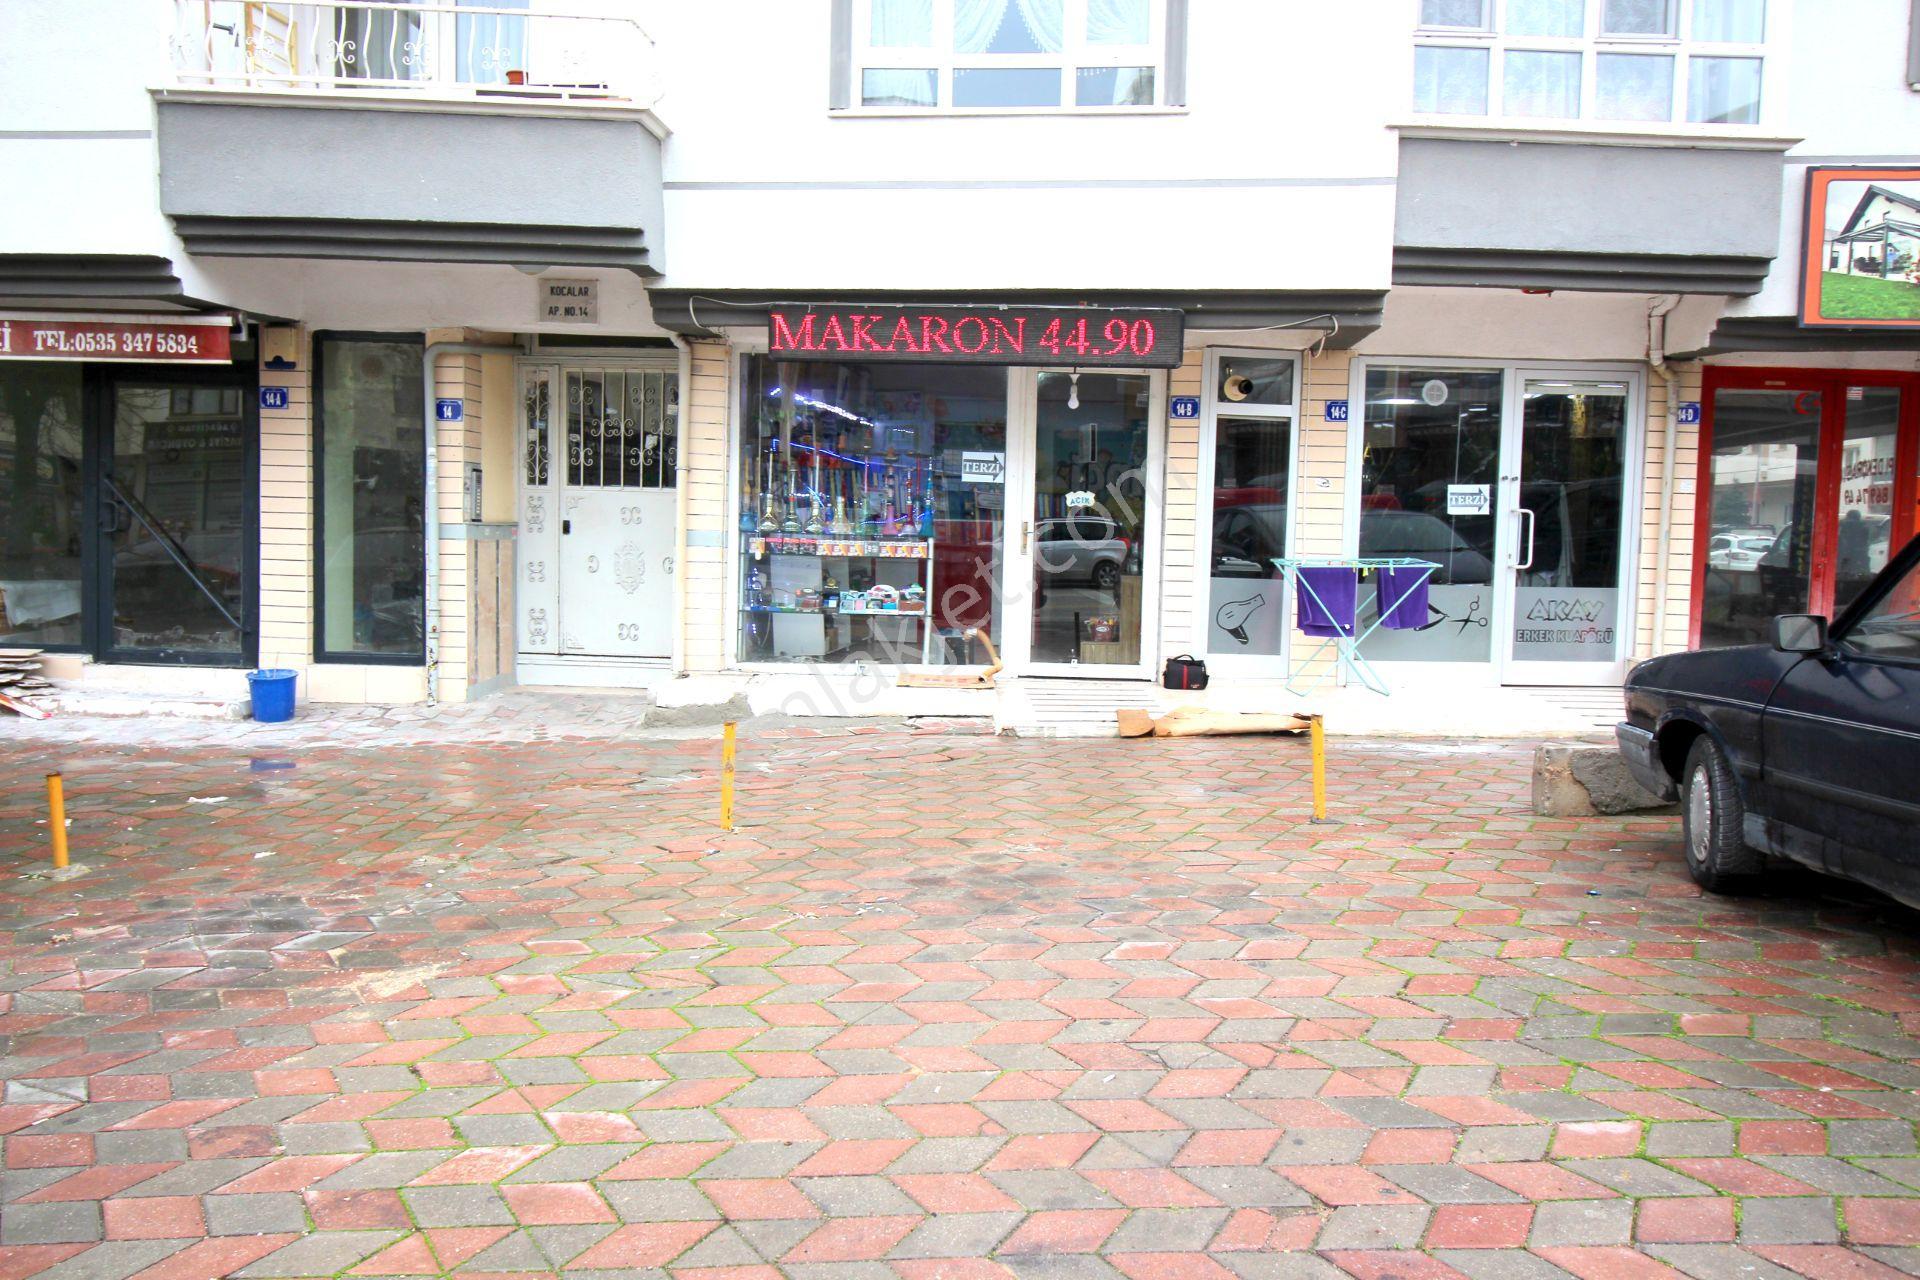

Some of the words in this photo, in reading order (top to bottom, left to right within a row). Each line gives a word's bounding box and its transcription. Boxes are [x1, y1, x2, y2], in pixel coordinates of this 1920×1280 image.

[550, 286, 589, 297] KOCALAR
[770, 313, 1027, 354] MAKARON
[1038, 317, 1155, 356] 44.90
[122, 332, 152, 352] 347
[443, 405, 452, 418] 14
[1176, 403, 1192, 416] 14-B
[1330, 406, 1347, 419] 14-C
[963, 460, 1000, 474] TERZİ
[1450, 493, 1485, 505] TERZİ
[1526, 598, 1605, 622] AKAY
[1516, 629, 1555, 643] ERKEK
